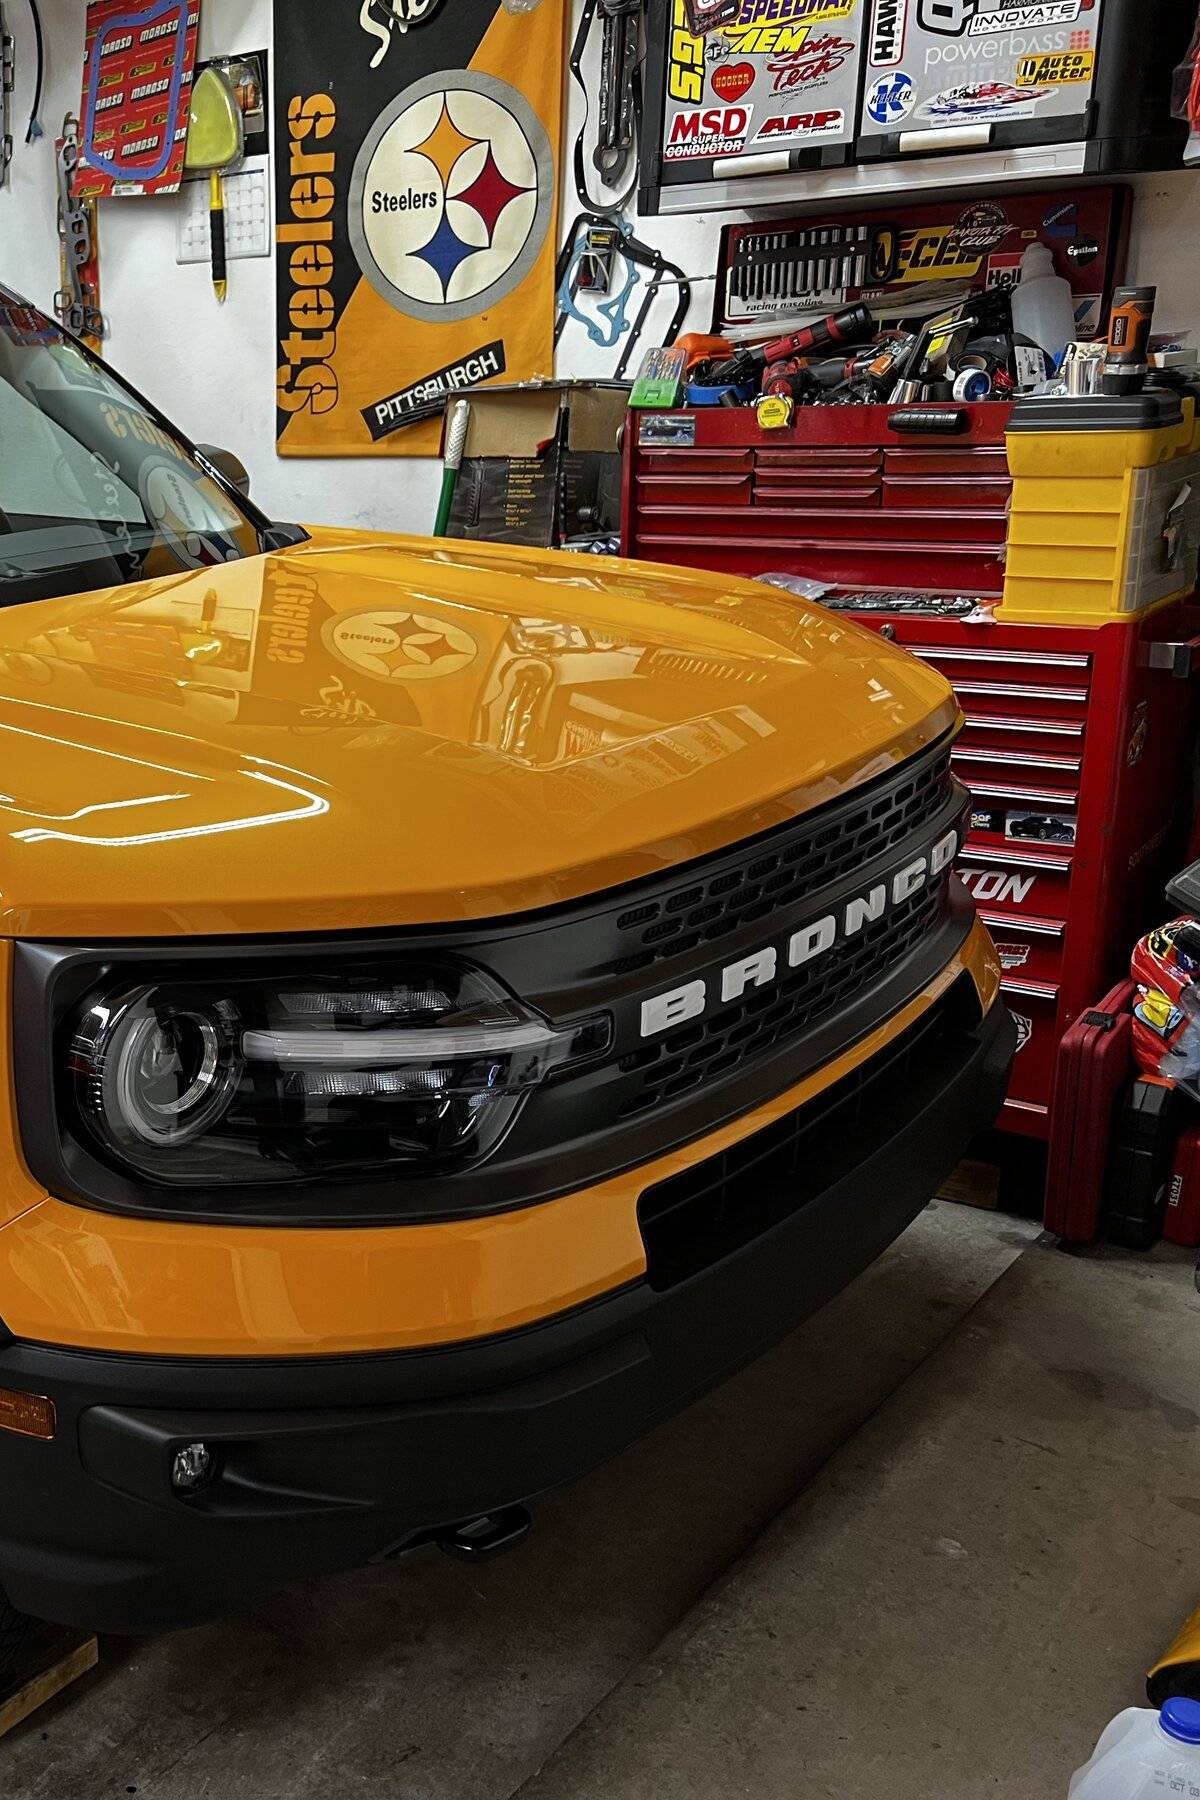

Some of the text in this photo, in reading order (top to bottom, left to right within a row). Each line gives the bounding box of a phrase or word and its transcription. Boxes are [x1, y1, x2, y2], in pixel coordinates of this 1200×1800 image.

[738, 0, 849, 25] SPEED
[972, 14, 1075, 33] MOTORSPORTS
[974, 3, 1077, 28] INNOVATE
[140, 19, 179, 43] MOROSO
[729, 26, 812, 54] AEM
[767, 51, 846, 91] Tech
[1040, 55, 1084, 70] Auto
[716, 73, 750, 88] HOOKER
[1035, 67, 1091, 83] Meter
[131, 78, 170, 100] MOROSO
[95, 92, 124, 111] OROSO
[670, 107, 748, 143] MSD
[757, 110, 843, 135] ARP
[122, 135, 160, 156] MOROSO
[665, 141, 743, 158] CONDUCTOR
[689, 134, 726, 146] SUPER
[371, 188, 438, 215] Steelers
[1042, 203, 1075, 227] Cummins
[959, 235, 1002, 247] CLUB
[277, 92, 340, 416] Steelers
[745, 297, 824, 313] racing gasoline
[375, 350, 500, 427] PITTSBURGH
[641, 830, 957, 1037] BRONCO
